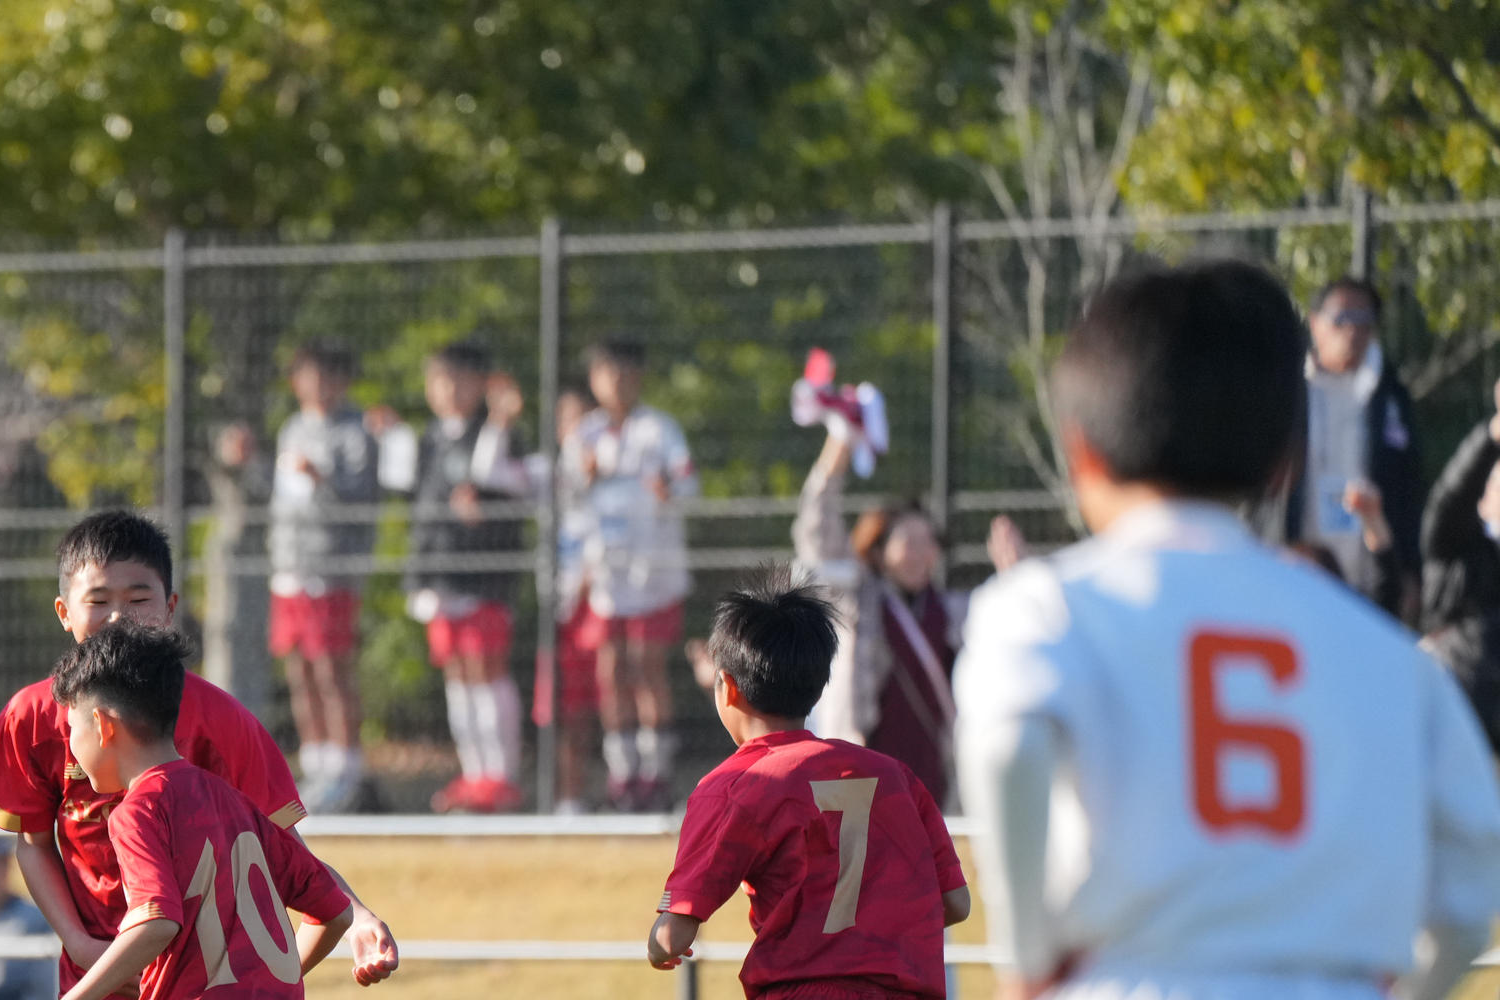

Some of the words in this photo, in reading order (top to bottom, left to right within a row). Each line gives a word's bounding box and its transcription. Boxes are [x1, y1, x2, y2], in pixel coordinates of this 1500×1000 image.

[1187, 626, 1308, 845] 6
[183, 831, 302, 991] 10
[809, 777, 879, 934] 7
